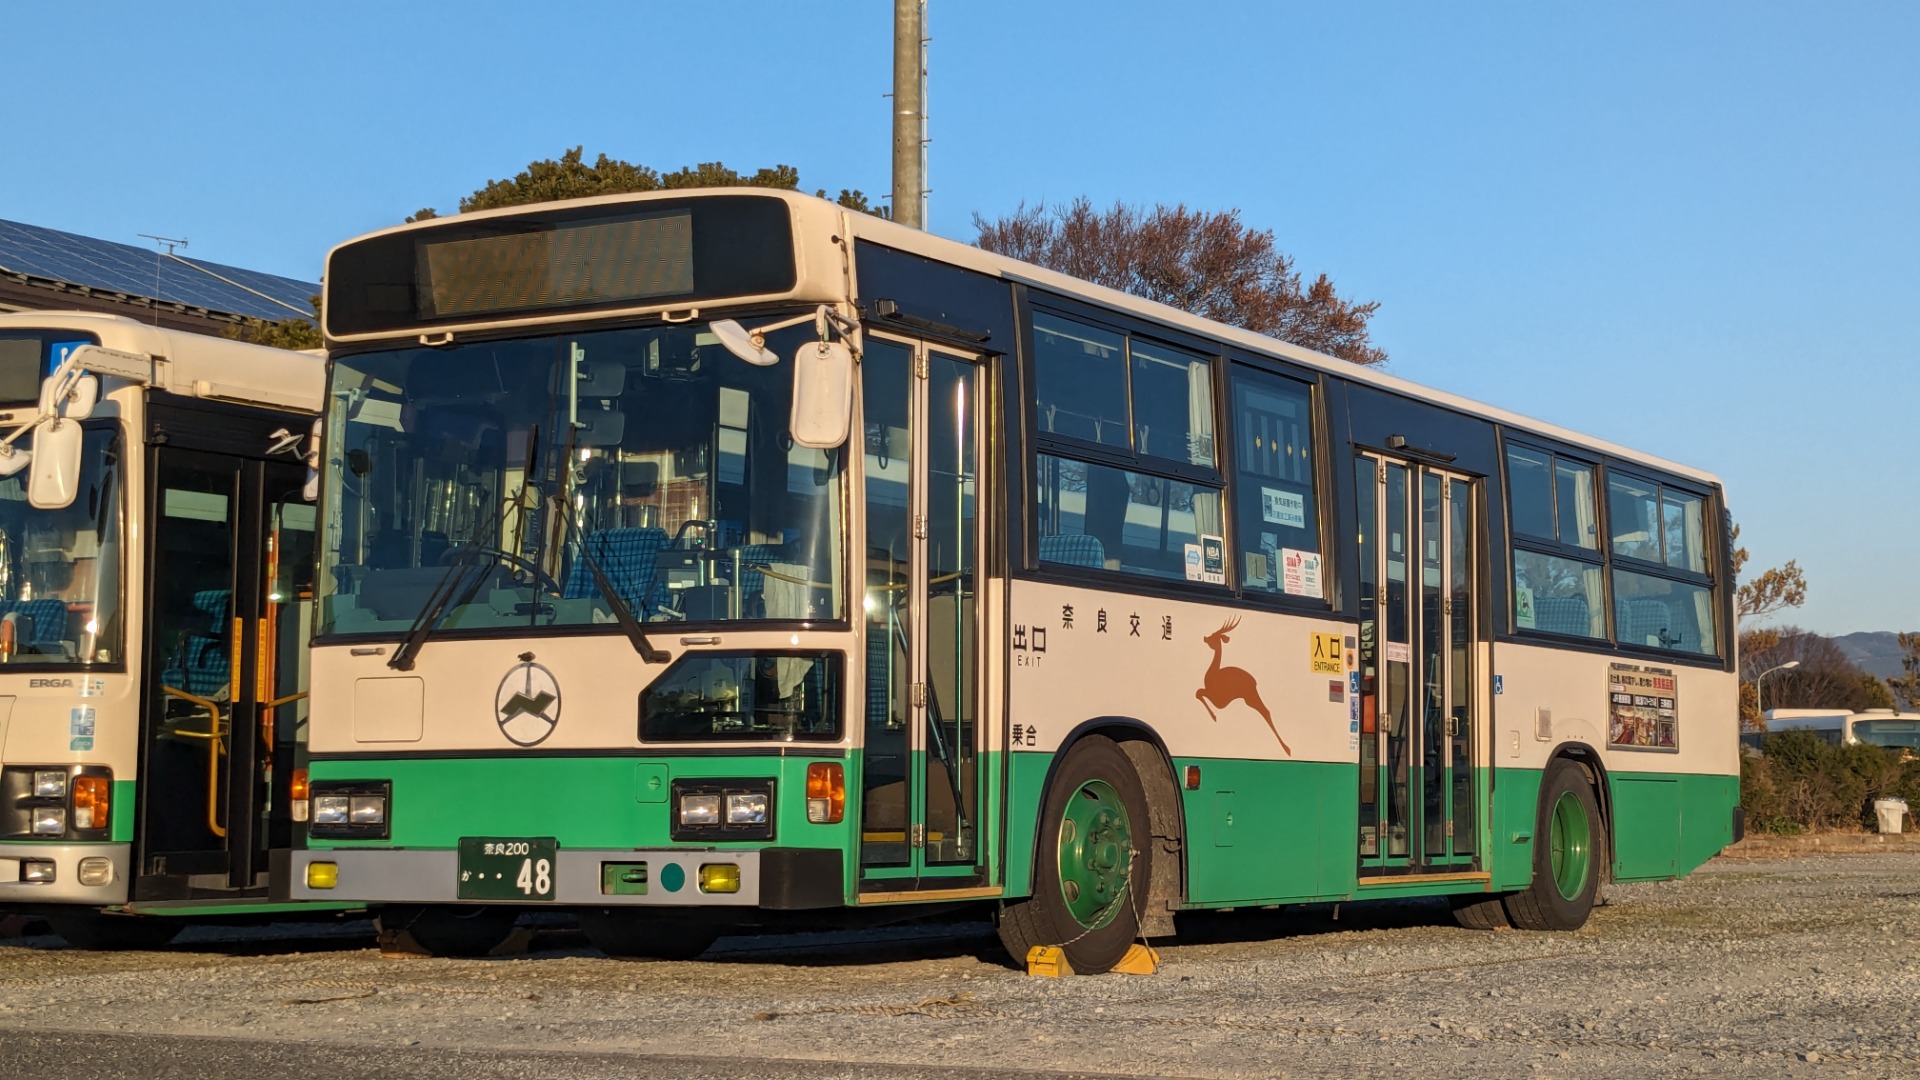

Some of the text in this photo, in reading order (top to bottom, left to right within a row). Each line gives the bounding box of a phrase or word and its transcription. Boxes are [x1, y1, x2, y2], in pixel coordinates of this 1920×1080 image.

[1062, 604, 1172, 640] 奈良交通
[1013, 623, 1047, 654] 出口
[1313, 635, 1341, 661] 入口
[1017, 654, 1042, 668] EXIT
[1313, 661, 1341, 674] ENTRANCE
[29, 679, 74, 689] ERGA
[1012, 724, 1037, 747] 乗合
[484, 843, 529, 855] 奈良200
[462, 858, 550, 895] か 48
